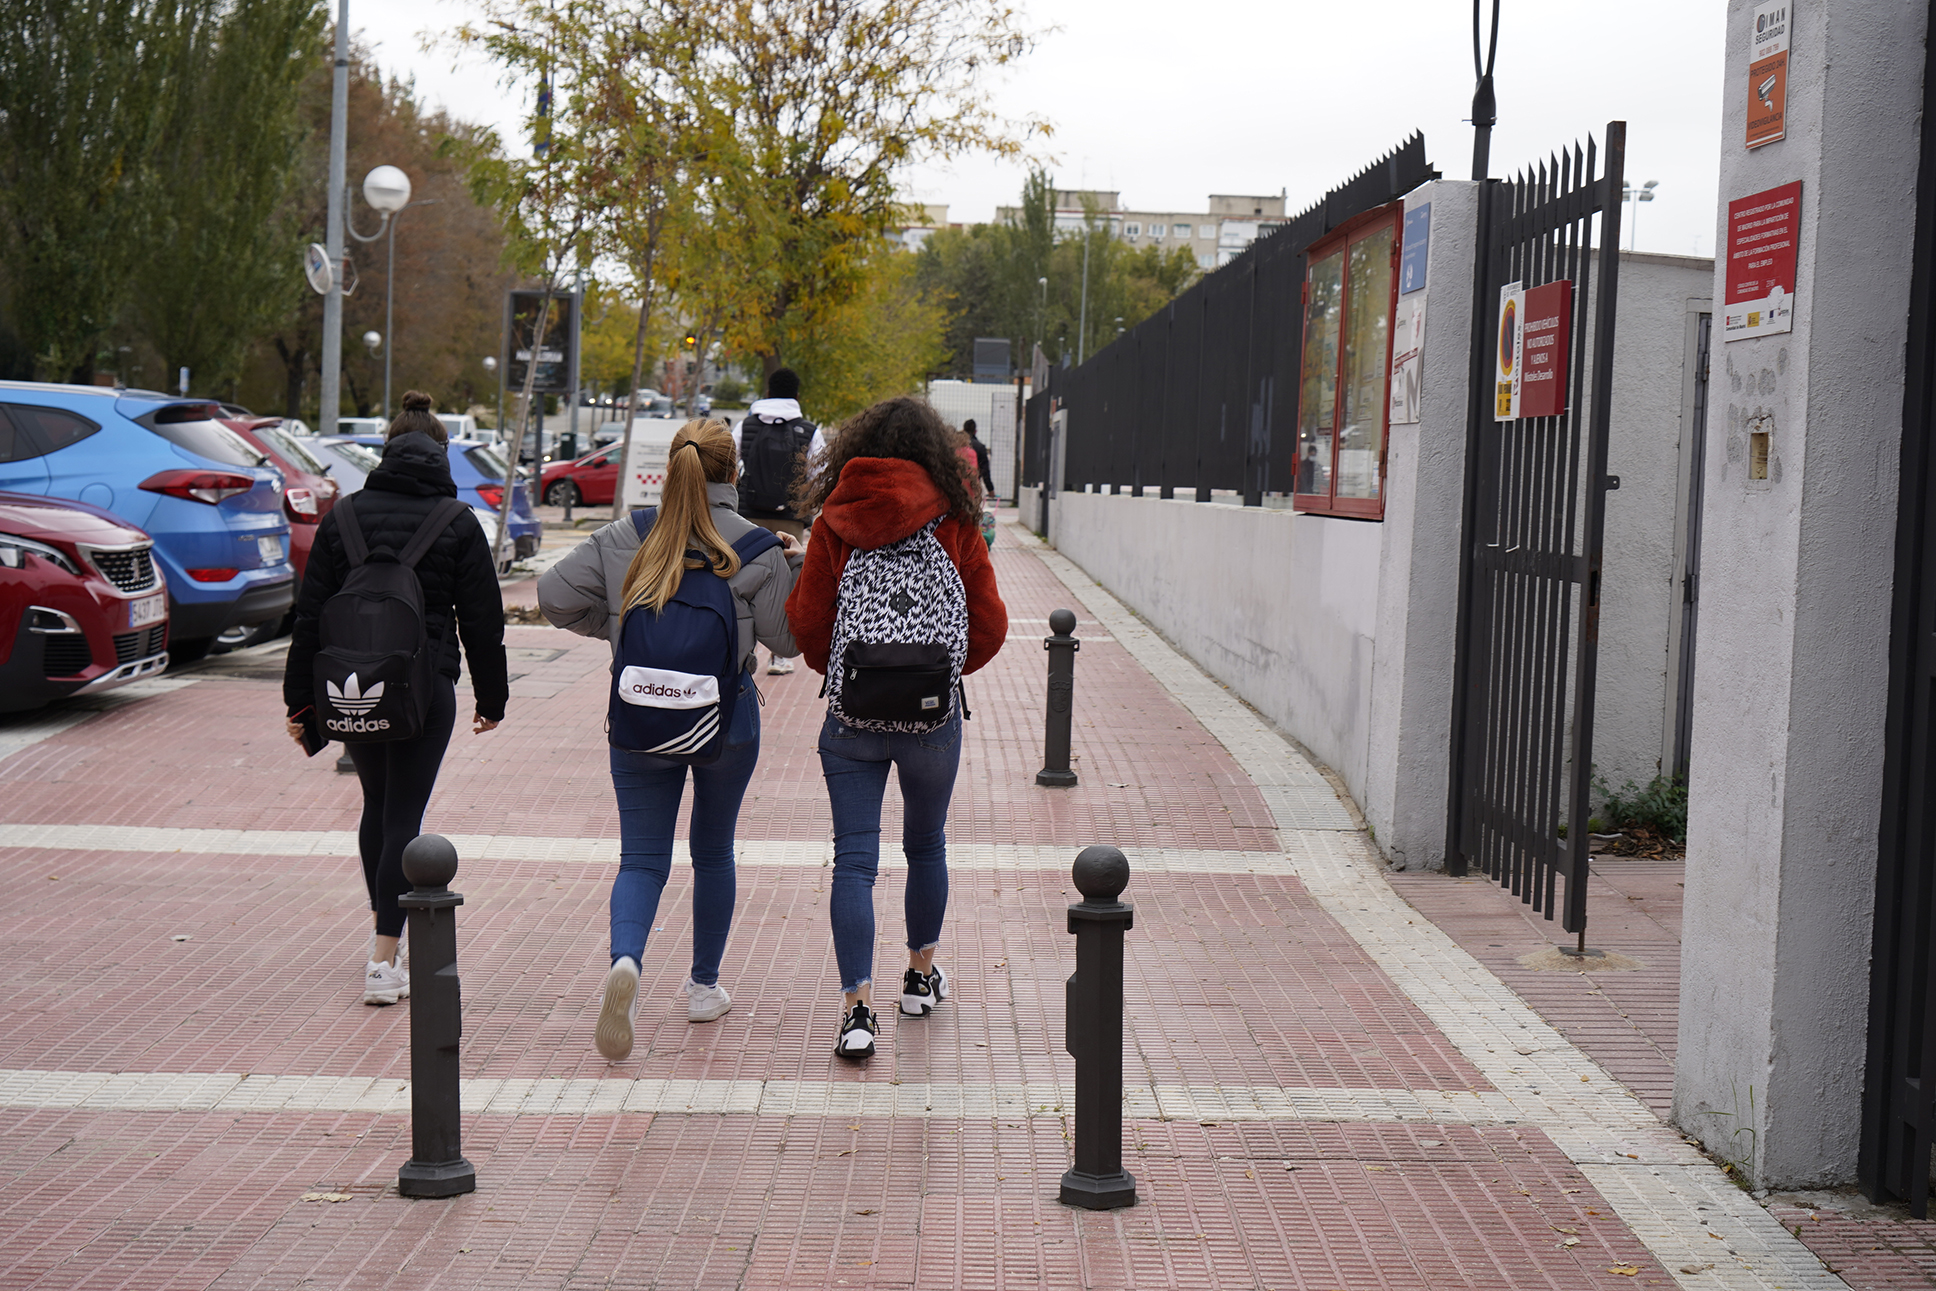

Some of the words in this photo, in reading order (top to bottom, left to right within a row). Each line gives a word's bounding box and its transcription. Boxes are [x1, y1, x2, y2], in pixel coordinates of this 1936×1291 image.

[1765, 7, 1786, 29] IMAN
[1755, 24, 1785, 45] SEGURIDAD
[1750, 62, 1775, 78] PROTEGIDO
[1748, 112, 1782, 131] VIDEOVIGILANCIA
[633, 683, 682, 698] adidas
[326, 717, 390, 733] adidas
